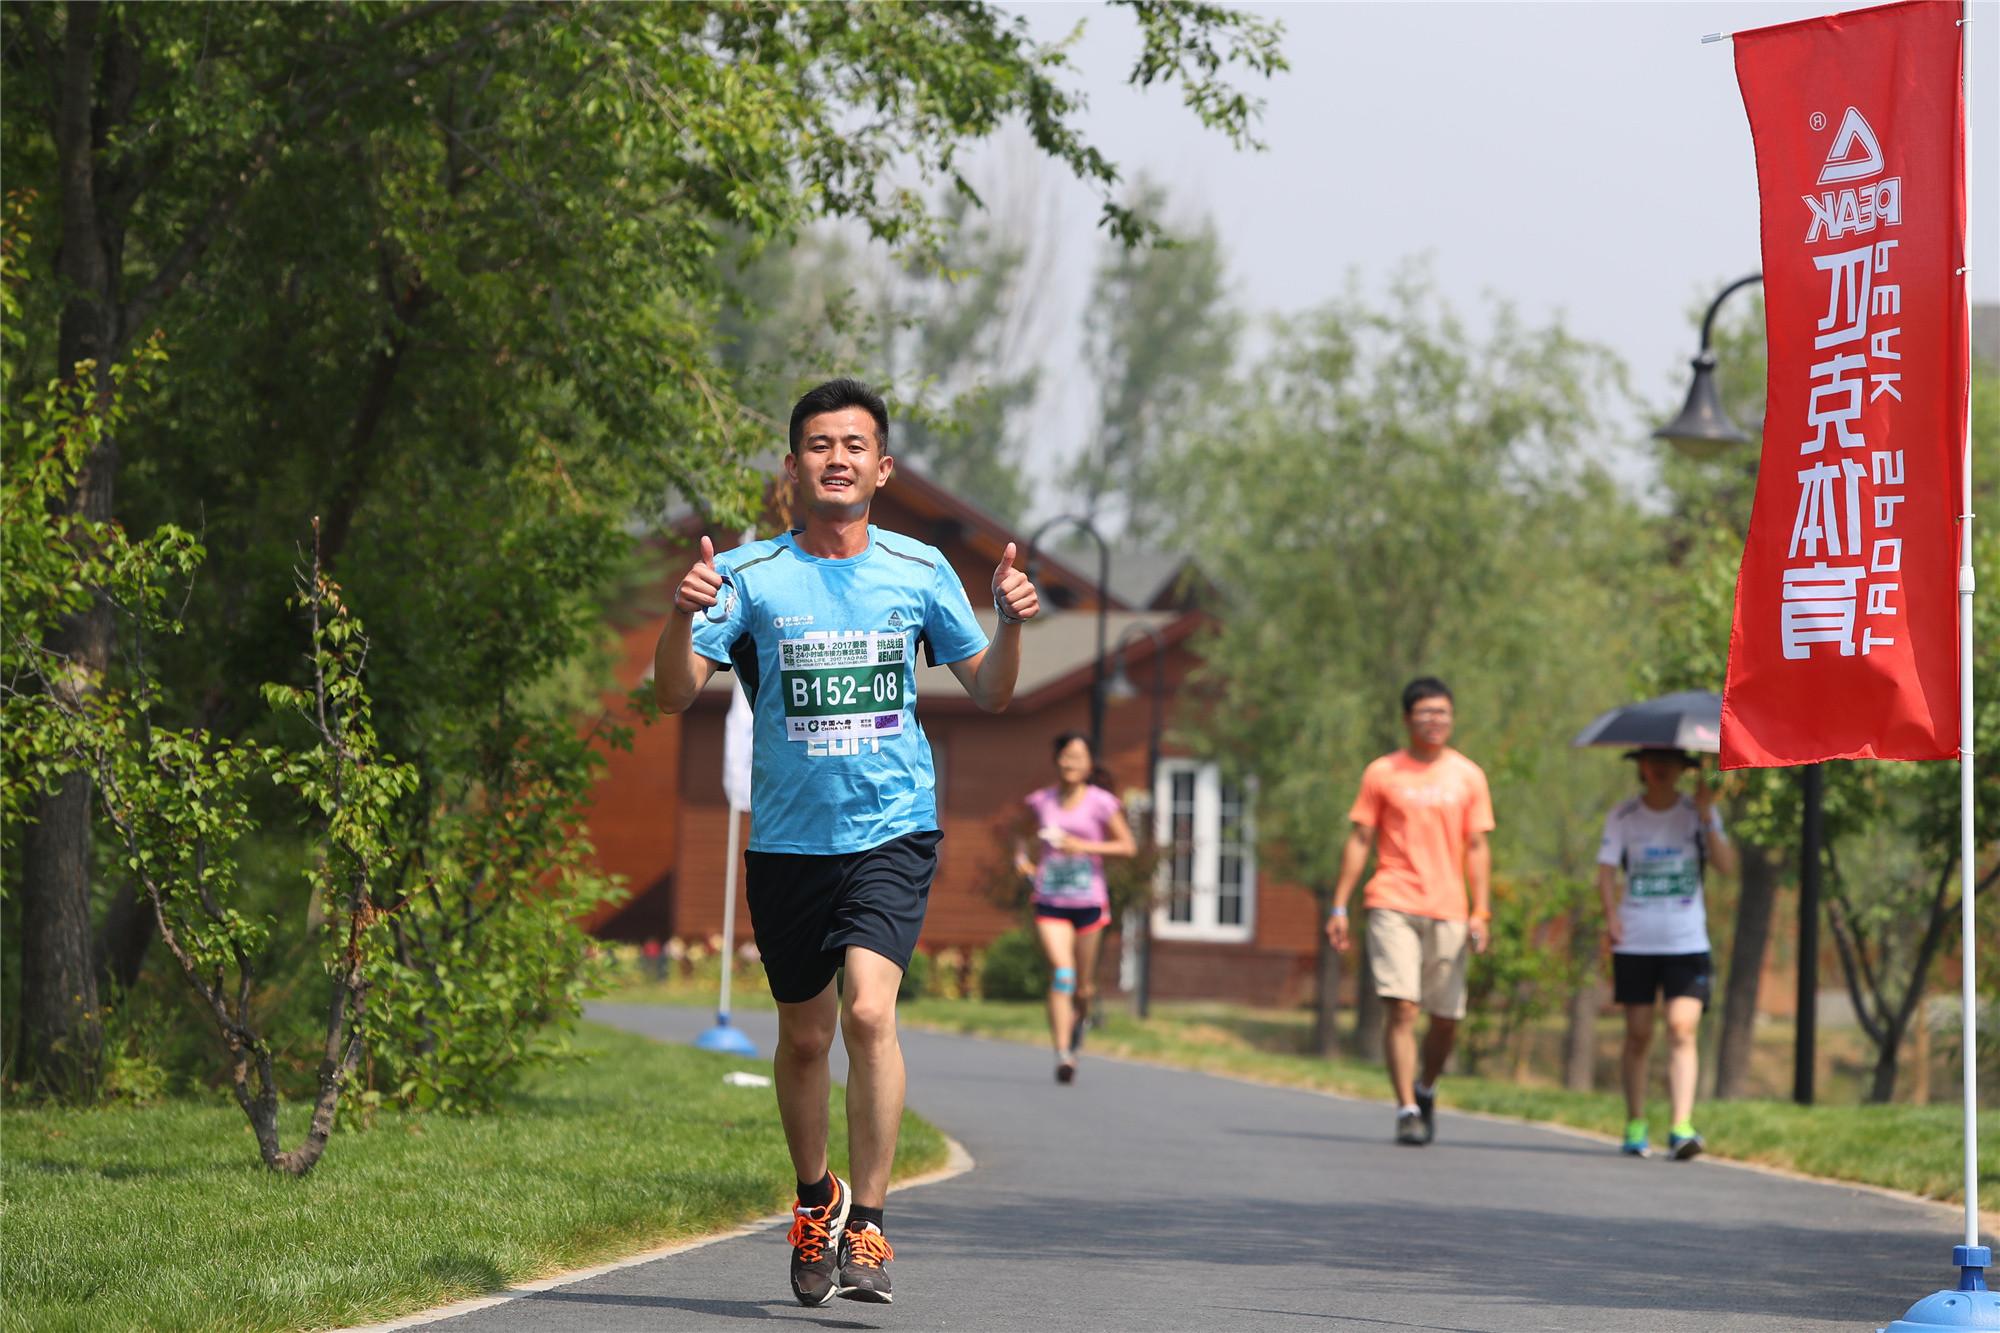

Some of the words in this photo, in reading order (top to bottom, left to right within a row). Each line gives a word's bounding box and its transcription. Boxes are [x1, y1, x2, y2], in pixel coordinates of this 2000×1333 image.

[877, 638, 904, 650] 挑战组
[878, 649, 903, 663] BEIJING
[791, 671, 898, 707] B152-08
